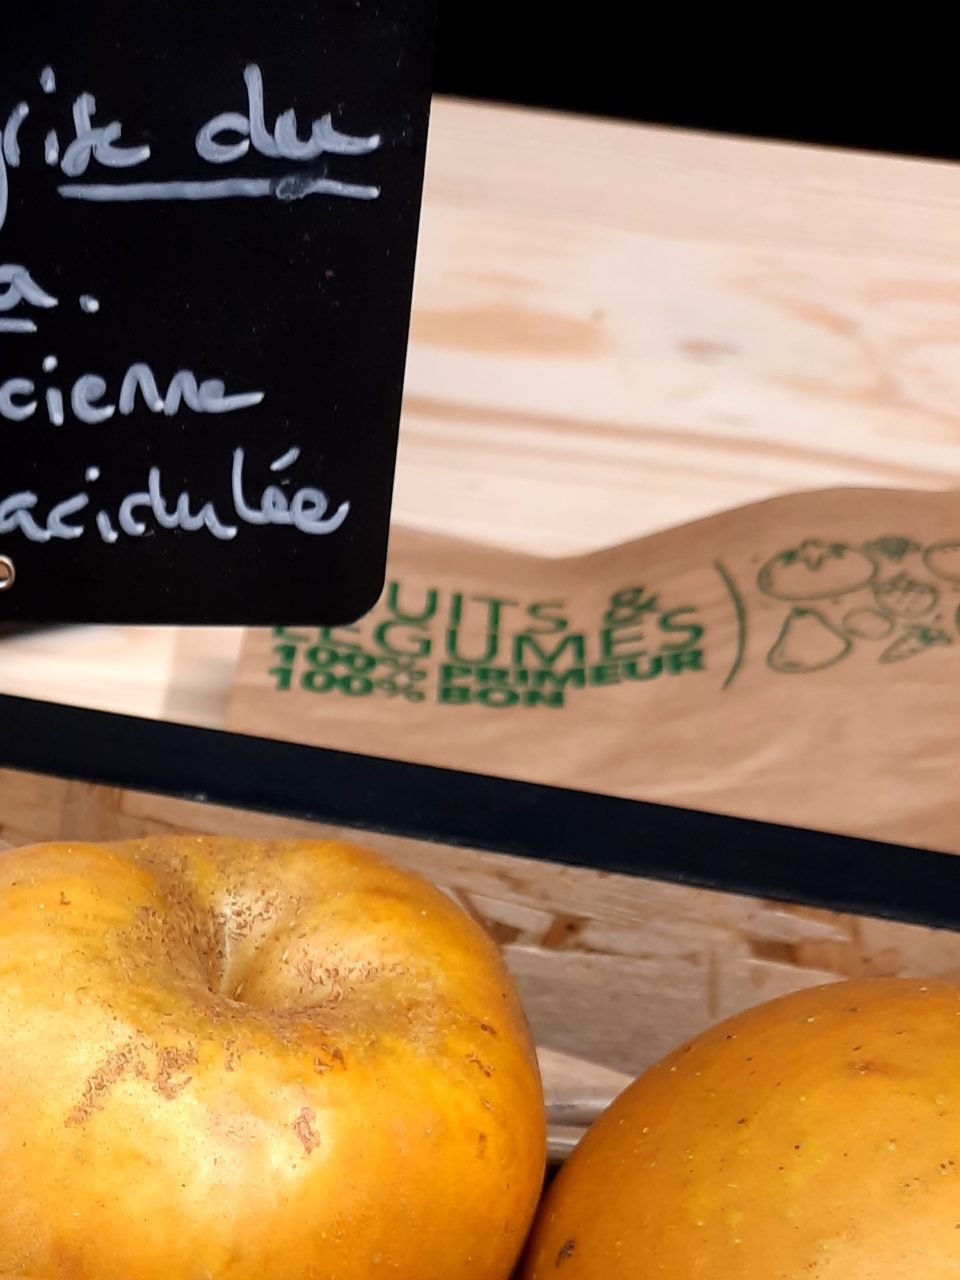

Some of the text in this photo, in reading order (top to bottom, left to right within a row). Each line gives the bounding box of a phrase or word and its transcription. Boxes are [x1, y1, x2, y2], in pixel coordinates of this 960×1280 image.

[195, 63, 381, 164] du
[387, 581, 568, 635] UITS
[268, 666, 566, 708] 100% BON
[273, 644, 706, 690] 100% PRIMEUR
